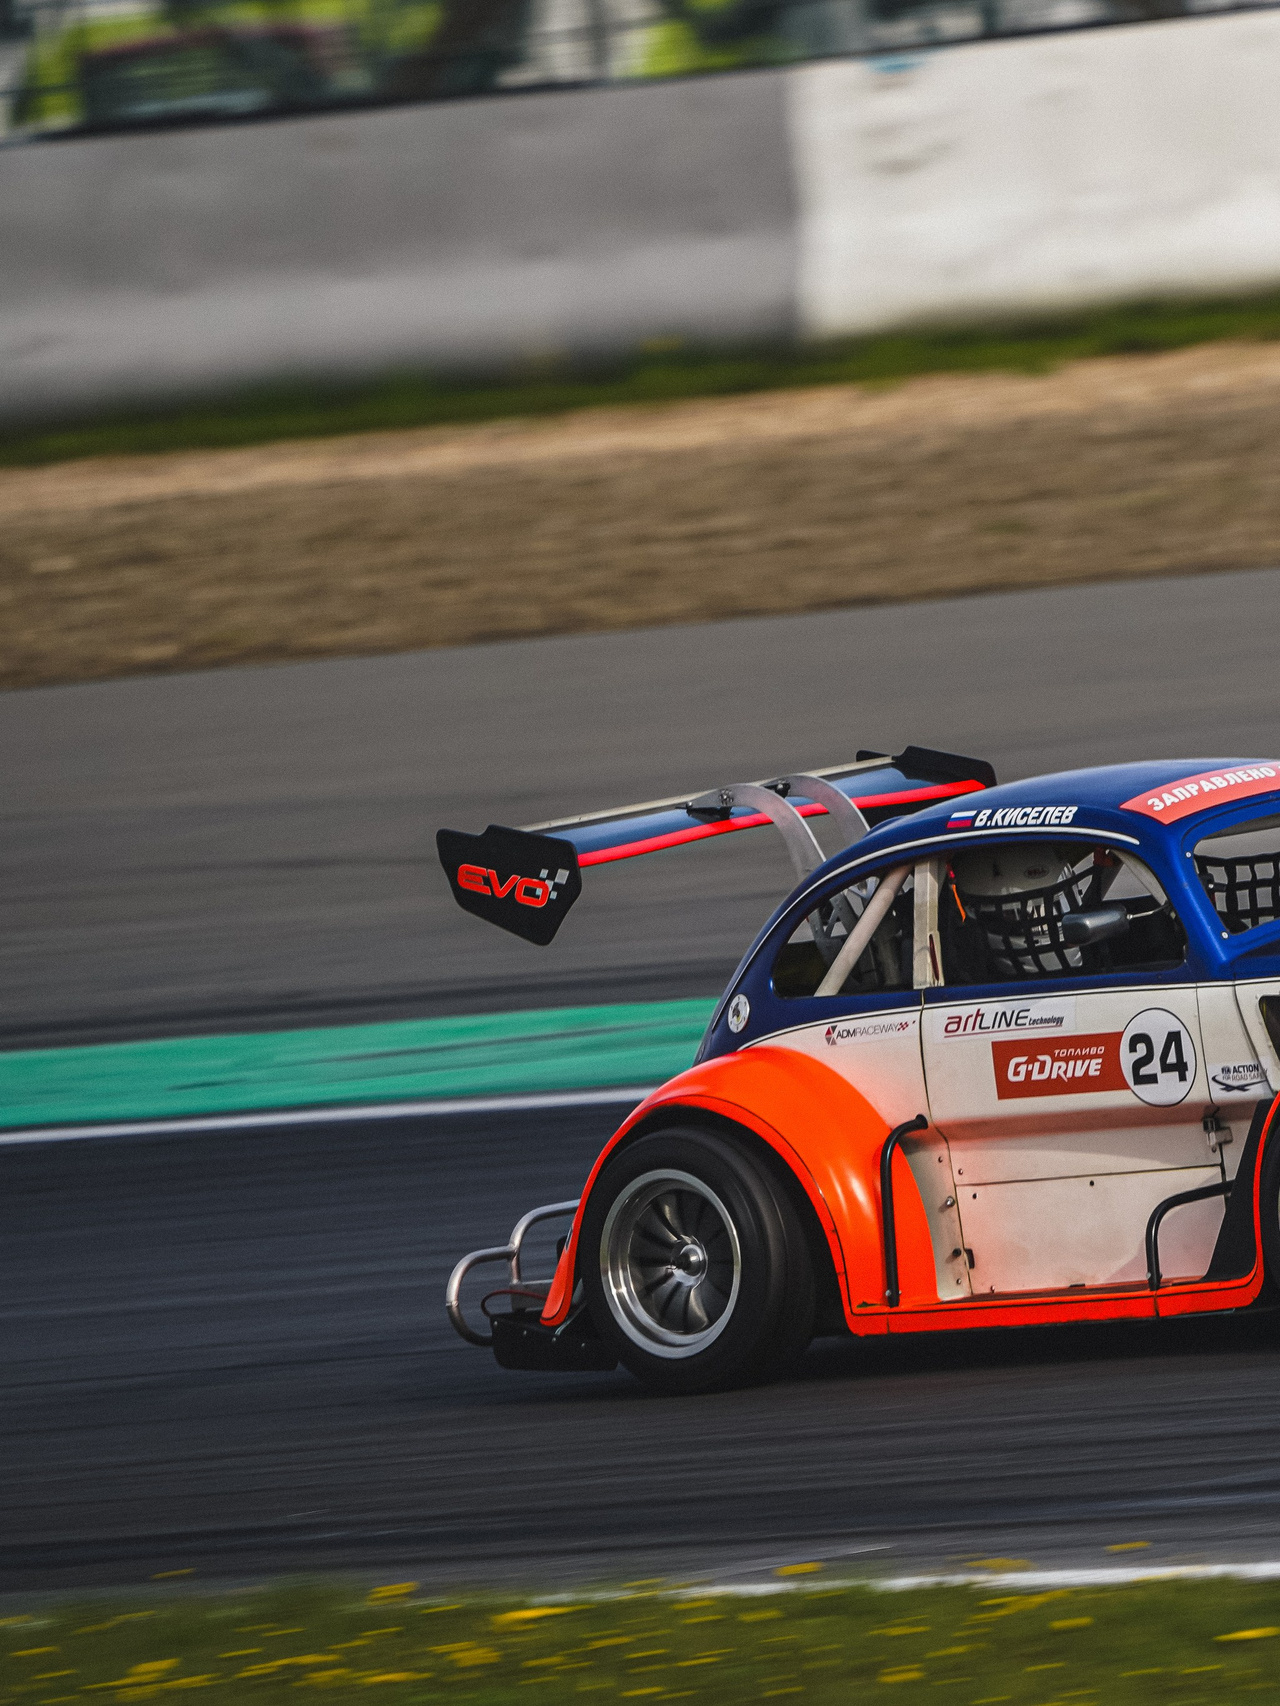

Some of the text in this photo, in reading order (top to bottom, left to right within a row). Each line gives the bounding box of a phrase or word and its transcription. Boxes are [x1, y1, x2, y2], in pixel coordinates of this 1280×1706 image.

[1147, 766, 1276, 812] ЗАПРАВЛЕНО
[974, 806, 1078, 827] В.КИСЕЛЕВ
[457, 863, 550, 908] EVO
[1028, 1016, 1064, 1026] technology
[1054, 1046, 1105, 1058] ТОПЛИВО
[1128, 1030, 1189, 1086] 24
[1232, 1064, 1259, 1074] ACTION
